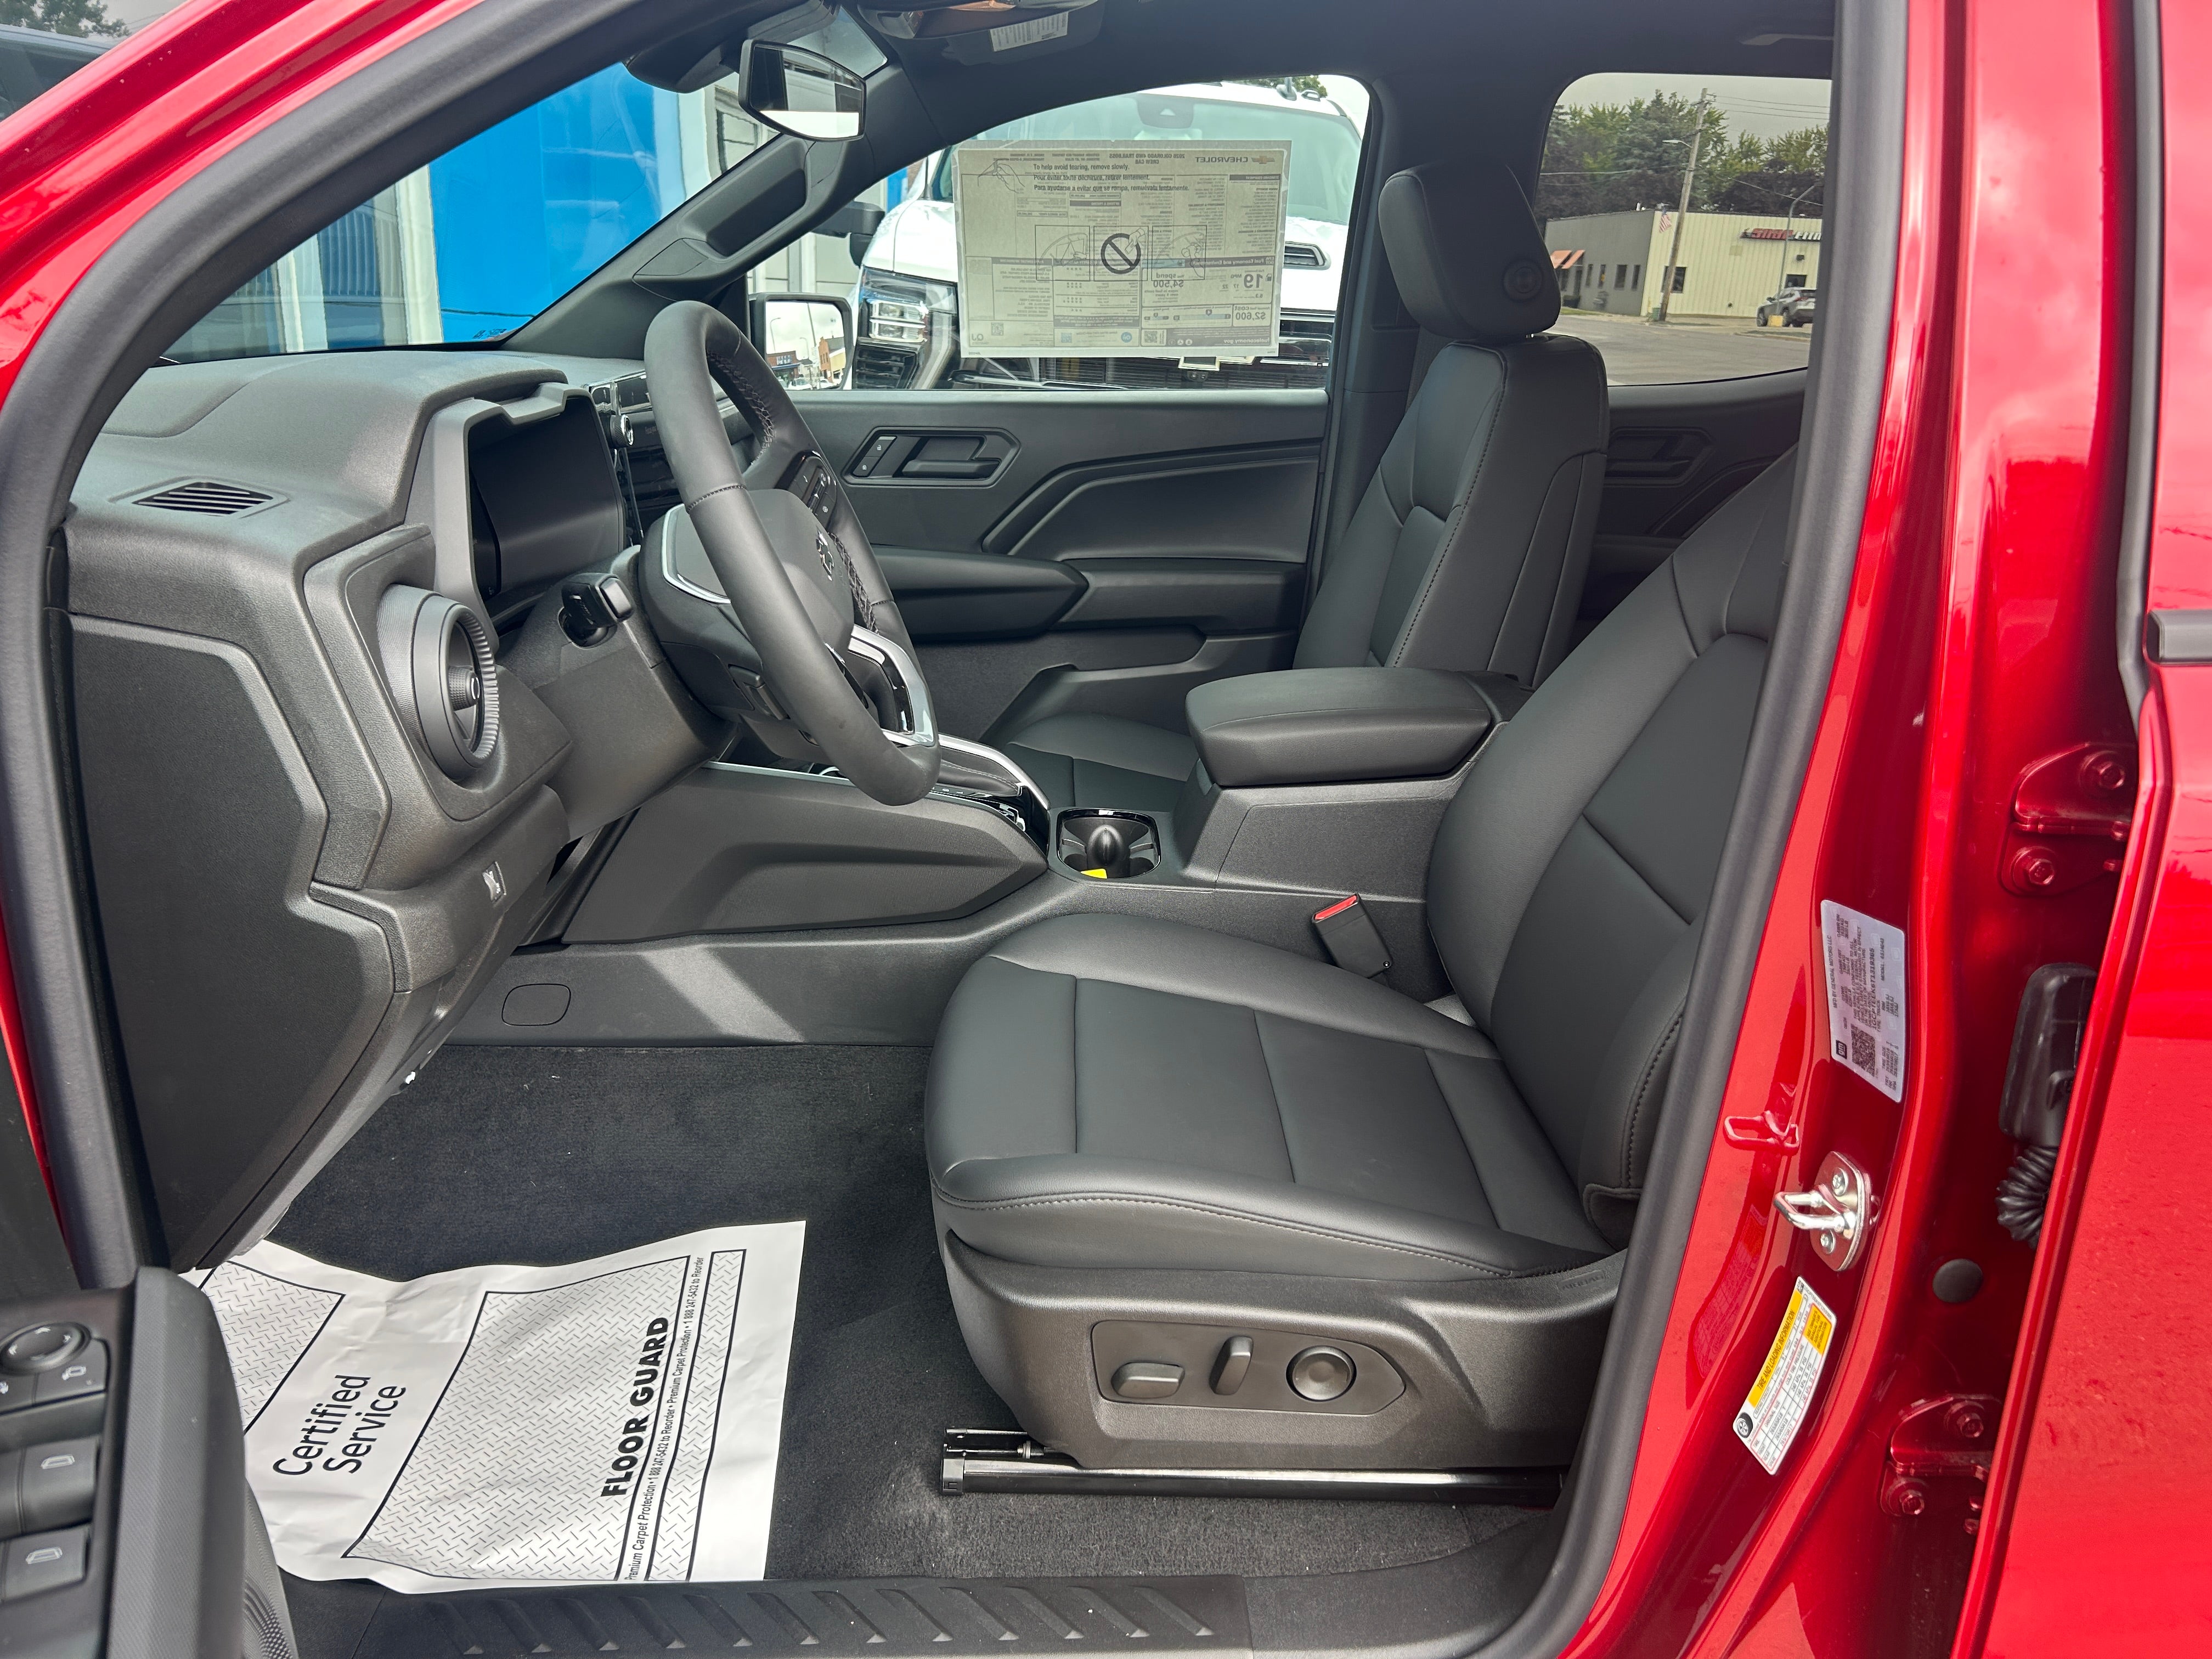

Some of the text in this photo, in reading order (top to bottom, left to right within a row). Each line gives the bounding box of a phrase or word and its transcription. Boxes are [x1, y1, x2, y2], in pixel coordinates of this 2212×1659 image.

[1838, 1043, 1845, 1056] gm
[691, 1257, 704, 1277] Reorder
[685, 1285, 699, 1308] 247-5432
[684, 1309, 695, 1319] 888
[676, 1330, 692, 1357] Protection
[1757, 1311, 1795, 1390] TIRE AND LOADING INFORMATION
[672, 1357, 687, 1376] Carpet
[667, 1376, 681, 1403] Premium
[1762, 1386, 1770, 1402] CAPACITY
[1764, 1408, 1775, 1427] ORIGINAL
[1793, 1345, 1804, 1364] PRESSURE
[600, 1317, 669, 1497] FLOOR GUARD
[273, 1375, 371, 1475] Certified
[323, 1386, 407, 1474] Service
[661, 1409, 675, 1434] Reorder
[1775, 1418, 1788, 1441] 265/65R18
[652, 1443, 669, 1466] 247-5432
[648, 1467, 662, 1476] 888
[637, 1485, 656, 1521] Protection
[632, 1522, 650, 1551] Carpet
[624, 1553, 642, 1581] Premium
